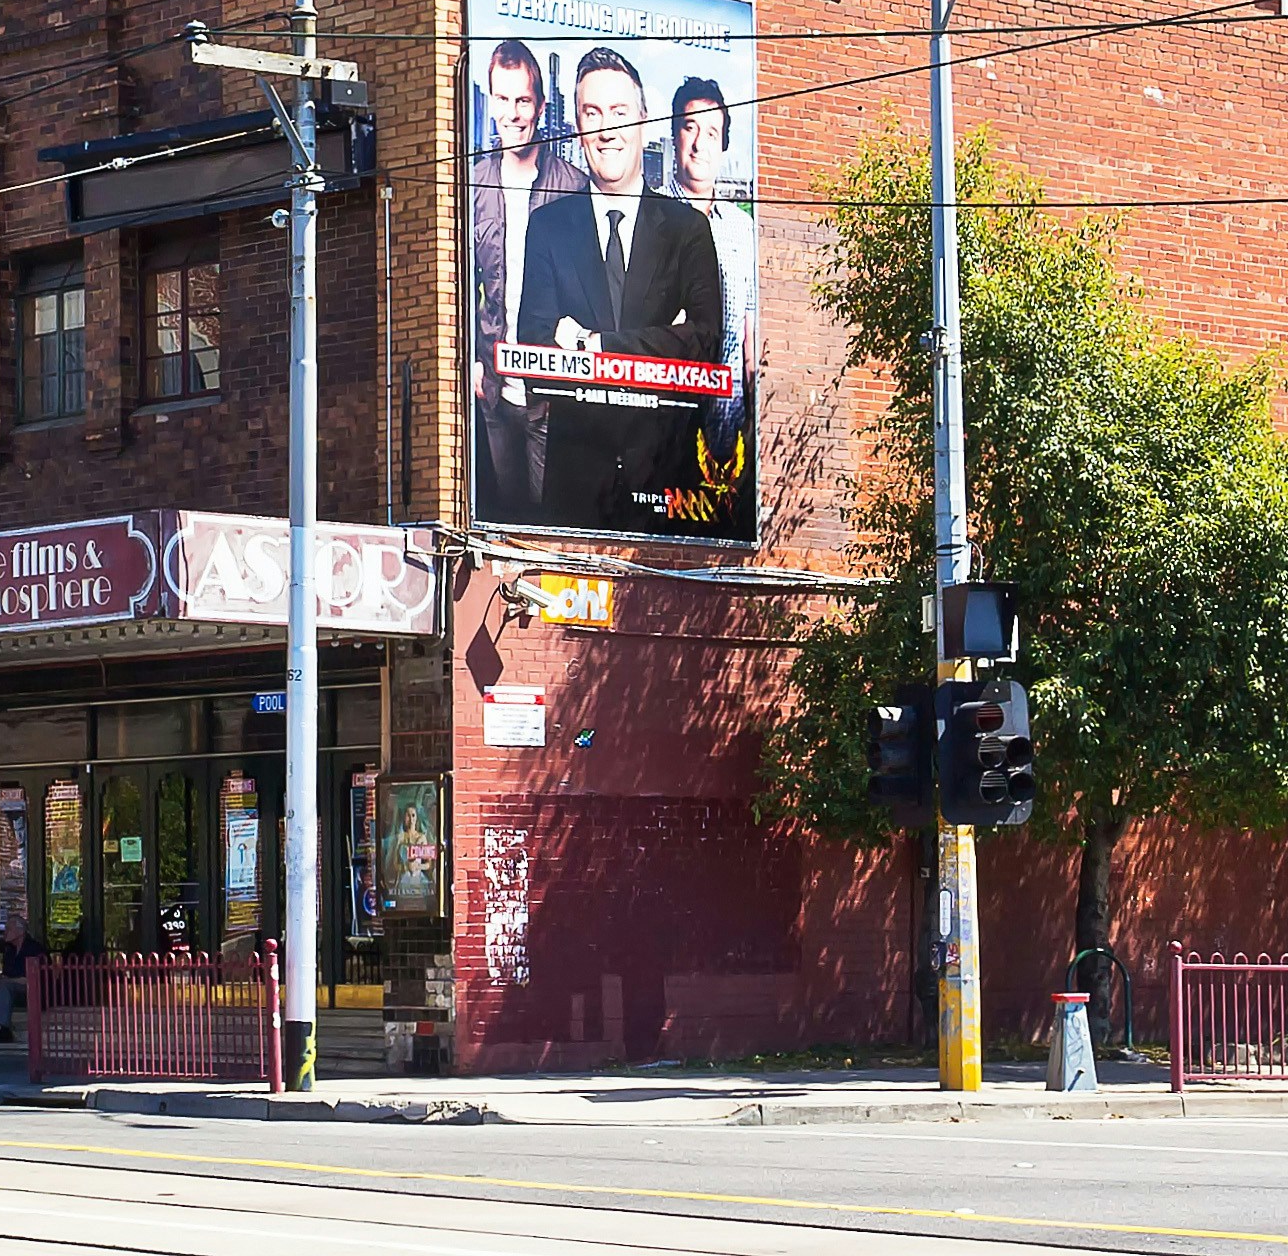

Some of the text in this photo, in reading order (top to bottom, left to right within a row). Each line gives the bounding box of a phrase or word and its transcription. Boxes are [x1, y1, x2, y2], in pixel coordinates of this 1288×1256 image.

[616, 7, 731, 52] MELBOURNE
[501, 349, 591, 376] TRIPLE M'S
[595, 358, 730, 391] HOT BREAKFAST
[607, 391, 658, 408] WEEKDAYS
[631, 492, 672, 504] TRIPLE
[9, 540, 77, 577] films
[82, 540, 104, 570] &
[258, 694, 284, 711] POOL
